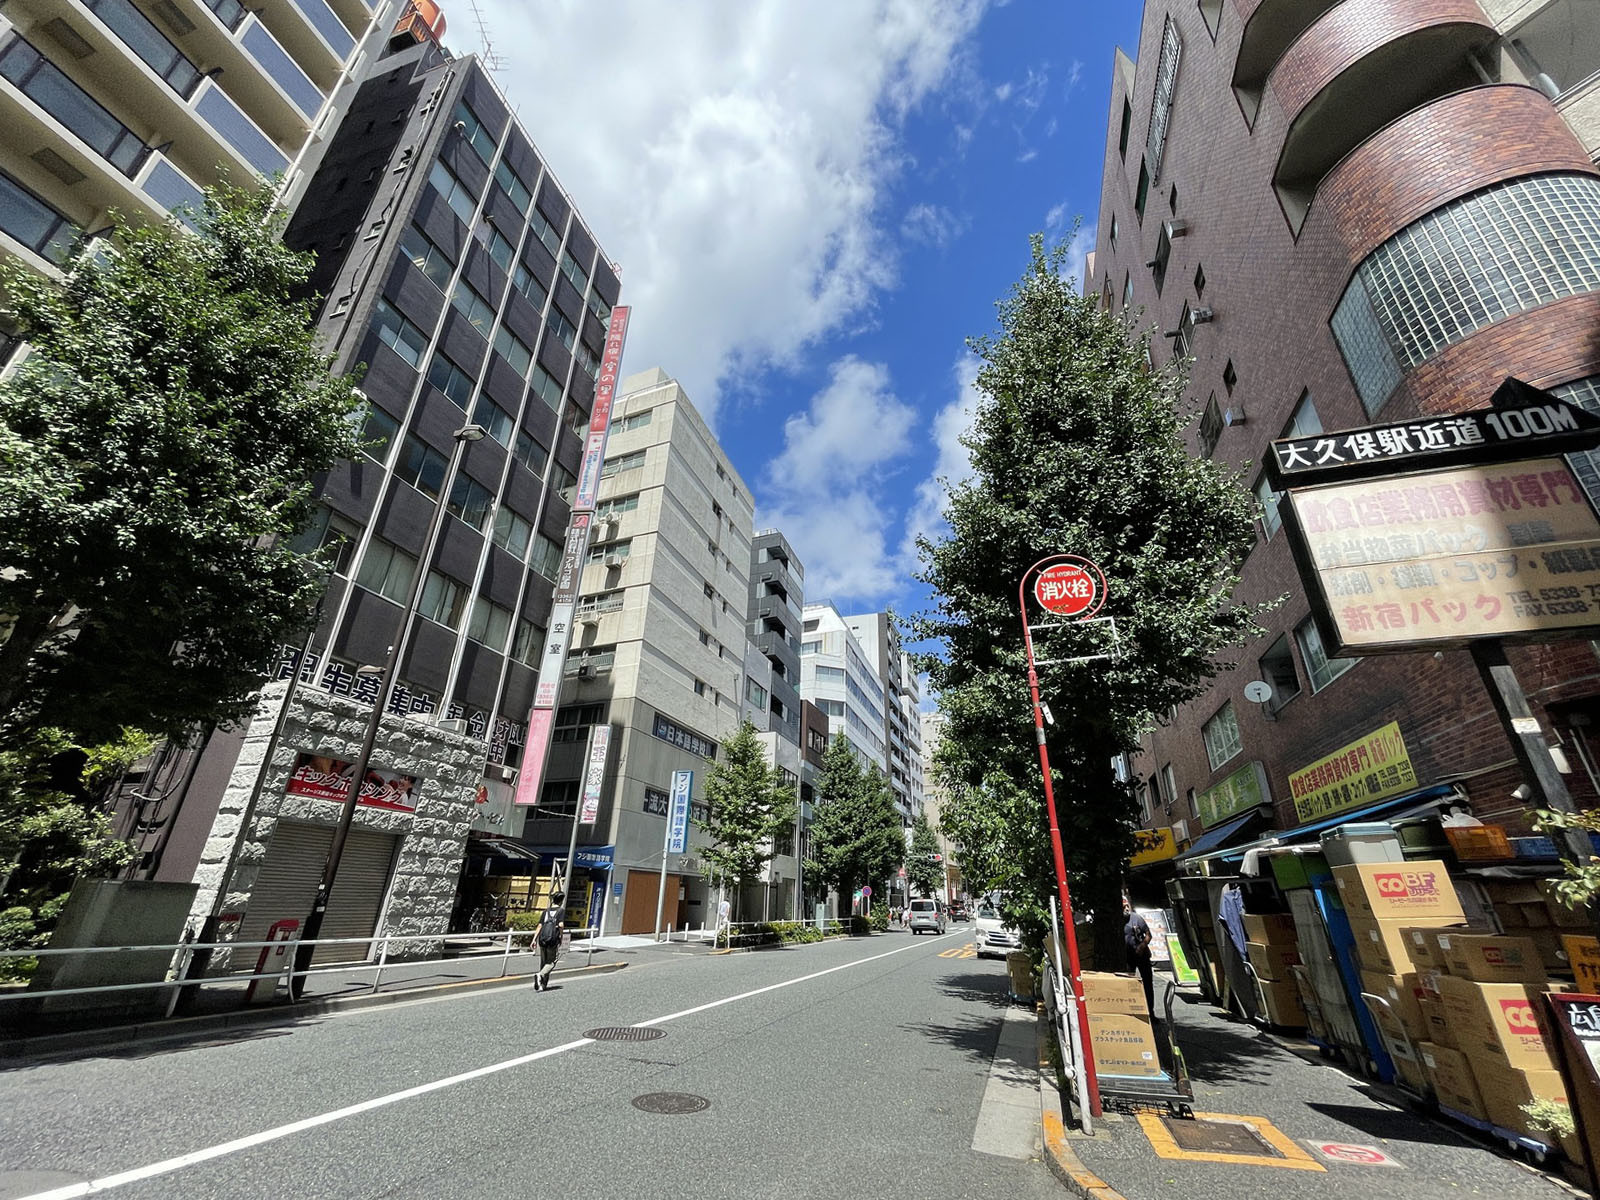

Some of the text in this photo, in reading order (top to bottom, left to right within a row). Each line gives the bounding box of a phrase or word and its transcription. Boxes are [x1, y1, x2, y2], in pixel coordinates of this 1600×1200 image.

[1279, 404, 1579, 469] 大久保駅近道 100M
[1041, 578, 1090, 601] 消火栓
[1342, 594, 1503, 632] 新宿パック
[549, 623, 566, 655] 空室
[667, 724, 706, 757] 日本語学校
[672, 774, 688, 849] フジ国際語学院
[1404, 872, 1436, 887] BF
